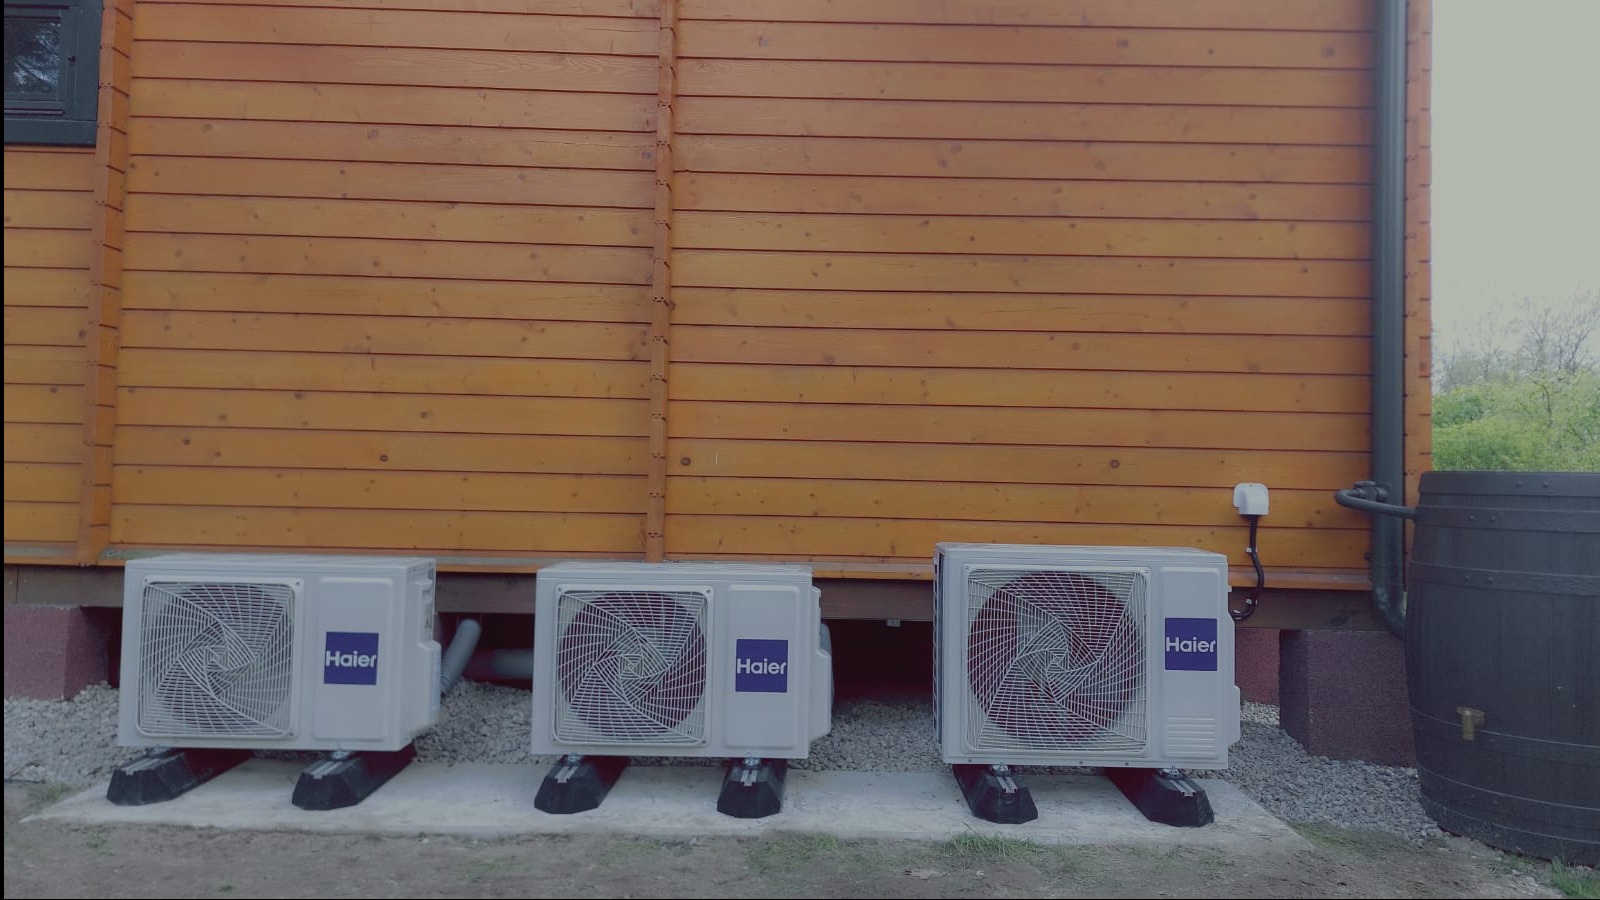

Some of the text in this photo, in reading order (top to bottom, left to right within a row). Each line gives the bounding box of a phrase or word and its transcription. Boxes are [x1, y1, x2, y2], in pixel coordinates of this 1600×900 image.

[1165, 636, 1216, 653] Haier
[325, 650, 377, 668] Haier
[736, 658, 787, 675] Haier
